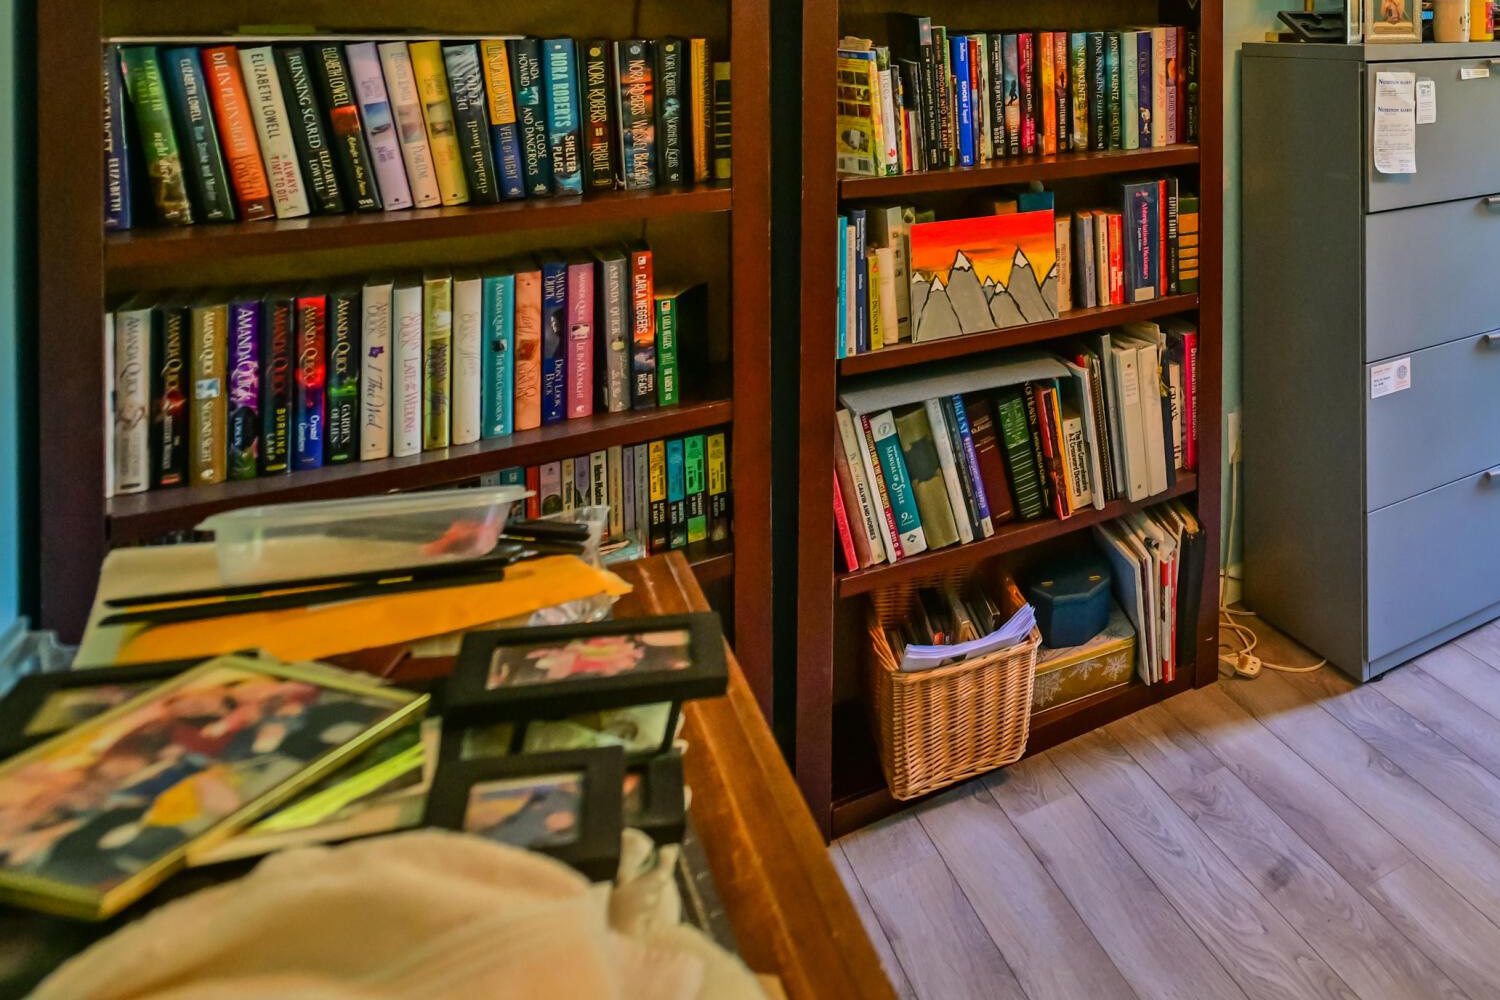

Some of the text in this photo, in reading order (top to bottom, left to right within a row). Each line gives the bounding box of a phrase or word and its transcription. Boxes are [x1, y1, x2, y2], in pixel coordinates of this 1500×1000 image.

[322, 47, 350, 106] ELIZABETH LOWELL
[518, 53, 530, 86] HOWARD
[529, 58, 539, 79] LINDA
[665, 54, 676, 70] NORA
[180, 58, 202, 121] ELIZABETH LOWELL
[251, 53, 280, 139] ELIZABETH LOWELL
[550, 52, 571, 127] NORA ROBERTS
[663, 72, 677, 96] ROBERTS
[938, 64, 946, 97] WINDOWS
[1111, 74, 1119, 100] KRENTZ
[290, 55, 321, 149] RUNNING SCARED
[587, 61, 610, 172] NORA ROBERTS TRIBUTE
[626, 60, 649, 173] NORA ROBERTS WHISKEY BEACH
[152, 132, 168, 156] night
[500, 126, 518, 180] VEIL NIGHT
[523, 107, 538, 176] AND DANGEROUS
[535, 120, 547, 159] UP CLOSE
[565, 135, 576, 173] SHELTER
[270, 155, 282, 176] TIME
[320, 150, 338, 196] ELIZABETH
[466, 121, 488, 194] elizabeth lowell
[553, 146, 563, 173] PLACE
[275, 178, 284, 187] TO
[283, 161, 298, 194] ALWAYS
[308, 159, 324, 192] LOWELL
[545, 275, 555, 299] QUICK
[635, 274, 648, 334] CARLA NEGGERS
[231, 309, 258, 401] AMANDA QUICK
[299, 306, 318, 381] AMANDA QUICK
[331, 300, 351, 375] AMANDA QUICK
[367, 376, 384, 398] Thee
[545, 373, 554, 396] BACK
[554, 384, 564, 407] LOOK
[637, 373, 648, 396] REACH
[276, 408, 286, 455] BURNING
[341, 404, 351, 443] GARDEN
[366, 402, 385, 429] Wed
[887, 446, 897, 473] MANUAL
[891, 482, 905, 504] STYLE
[858, 483, 876, 540] CALVIN AND HOBBES
